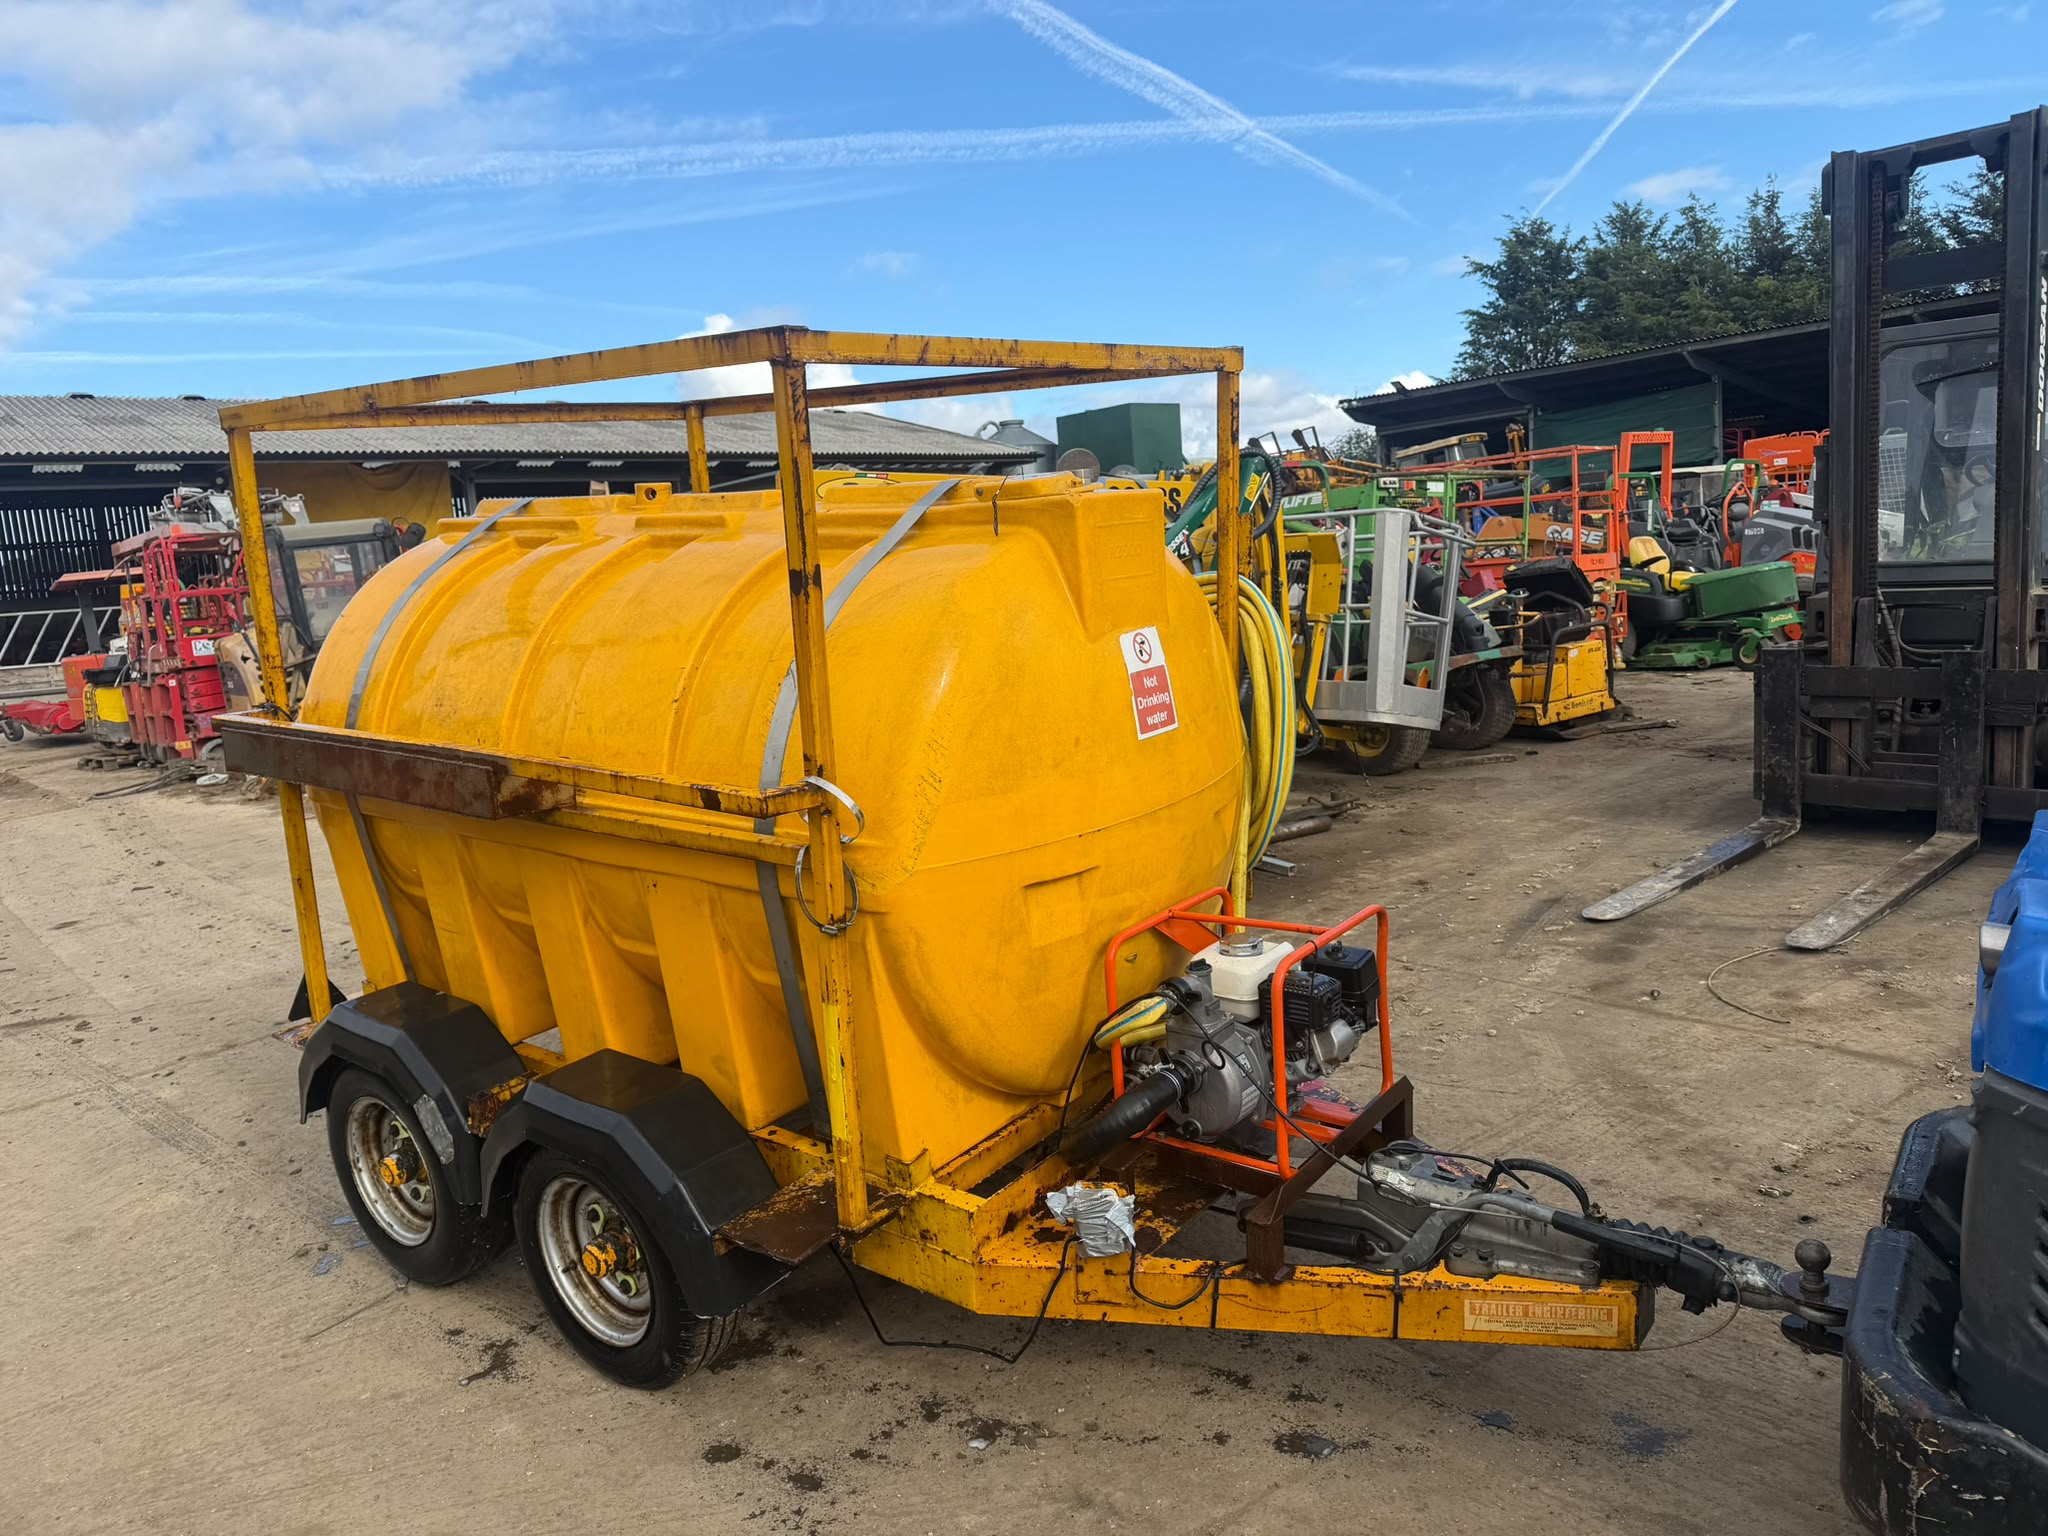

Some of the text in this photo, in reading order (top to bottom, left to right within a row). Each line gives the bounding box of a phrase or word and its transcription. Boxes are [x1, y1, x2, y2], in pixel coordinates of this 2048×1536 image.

[2037, 276, 2048, 413] DOOSAN
[1546, 524, 1604, 546] CASE
[1143, 674, 1158, 689] Not
[1137, 691, 1170, 710] Drinking
[1146, 711, 1168, 726] water
[1475, 1303, 1608, 1322] TRAILER ENGINEERING
